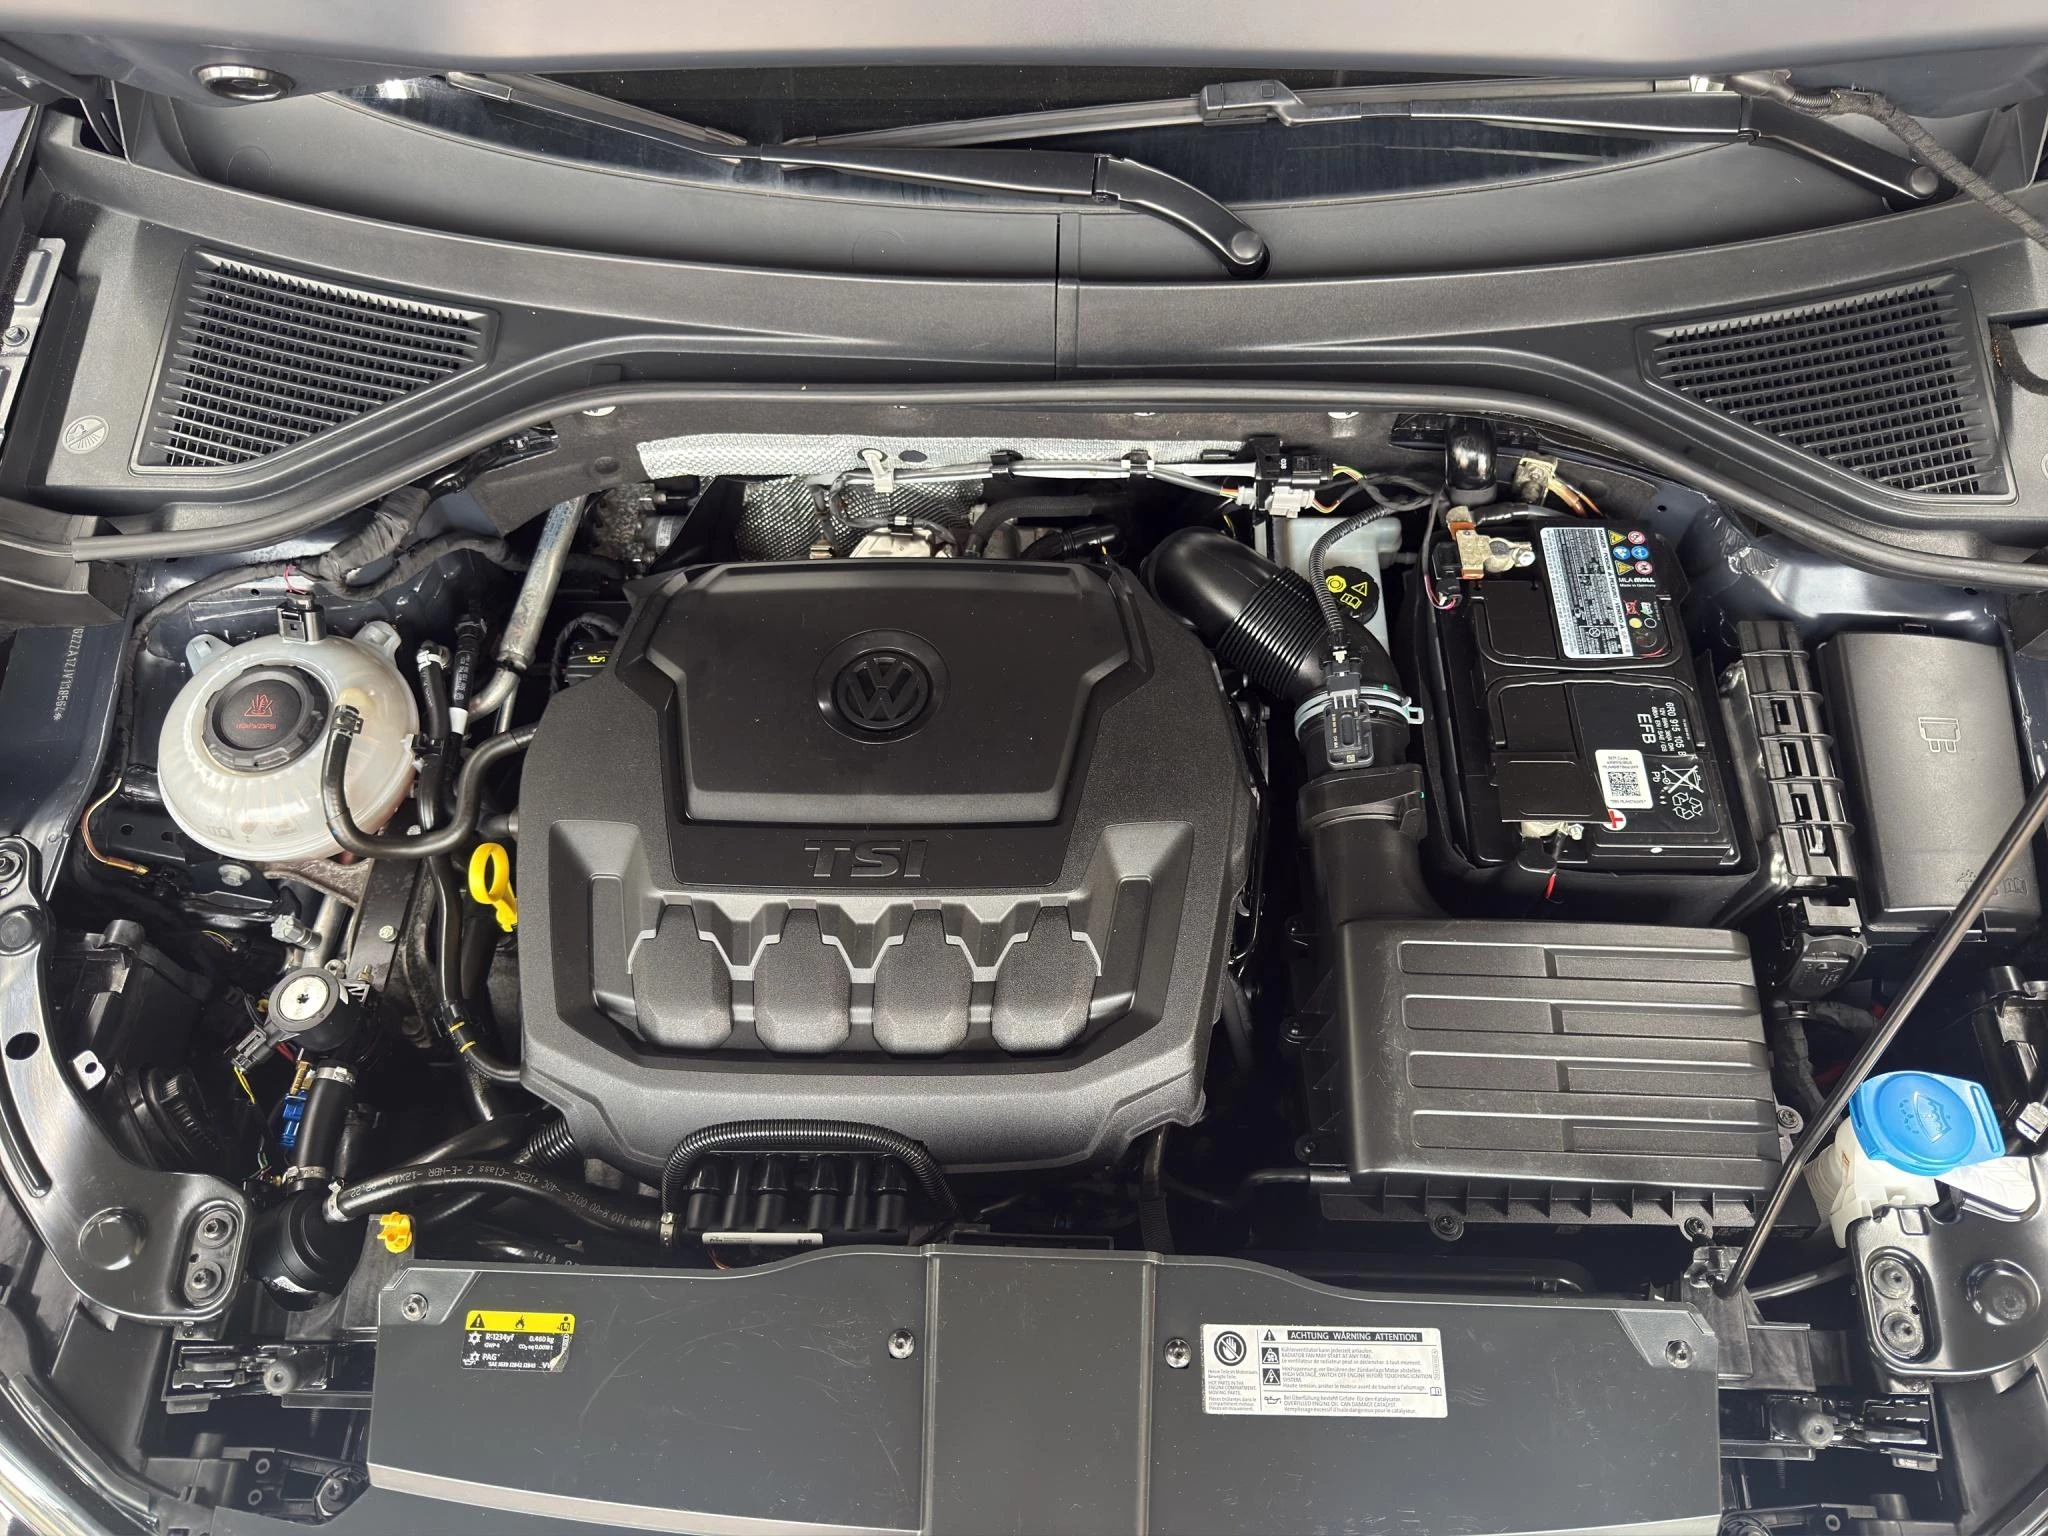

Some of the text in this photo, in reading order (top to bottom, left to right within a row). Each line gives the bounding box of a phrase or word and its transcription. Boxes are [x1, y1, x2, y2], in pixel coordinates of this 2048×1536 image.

[53, 626, 85, 721] GZZZA1ZJV118564
[837, 650, 927, 728] VW
[1665, 702, 1676, 716] 6R0
[1637, 714, 1656, 744] EFB
[1670, 718, 1680, 732] 915
[1674, 736, 1684, 748] 105
[1651, 772, 1661, 782] Pb
[804, 838, 929, 878] TSI
[467, 1165, 474, 1174] 2
[486, 1334, 515, 1343] R-1234yf
[547, 1336, 554, 1344] kg
[1290, 1332, 1417, 1341] ACHTUNG WARNING ATTENTION
